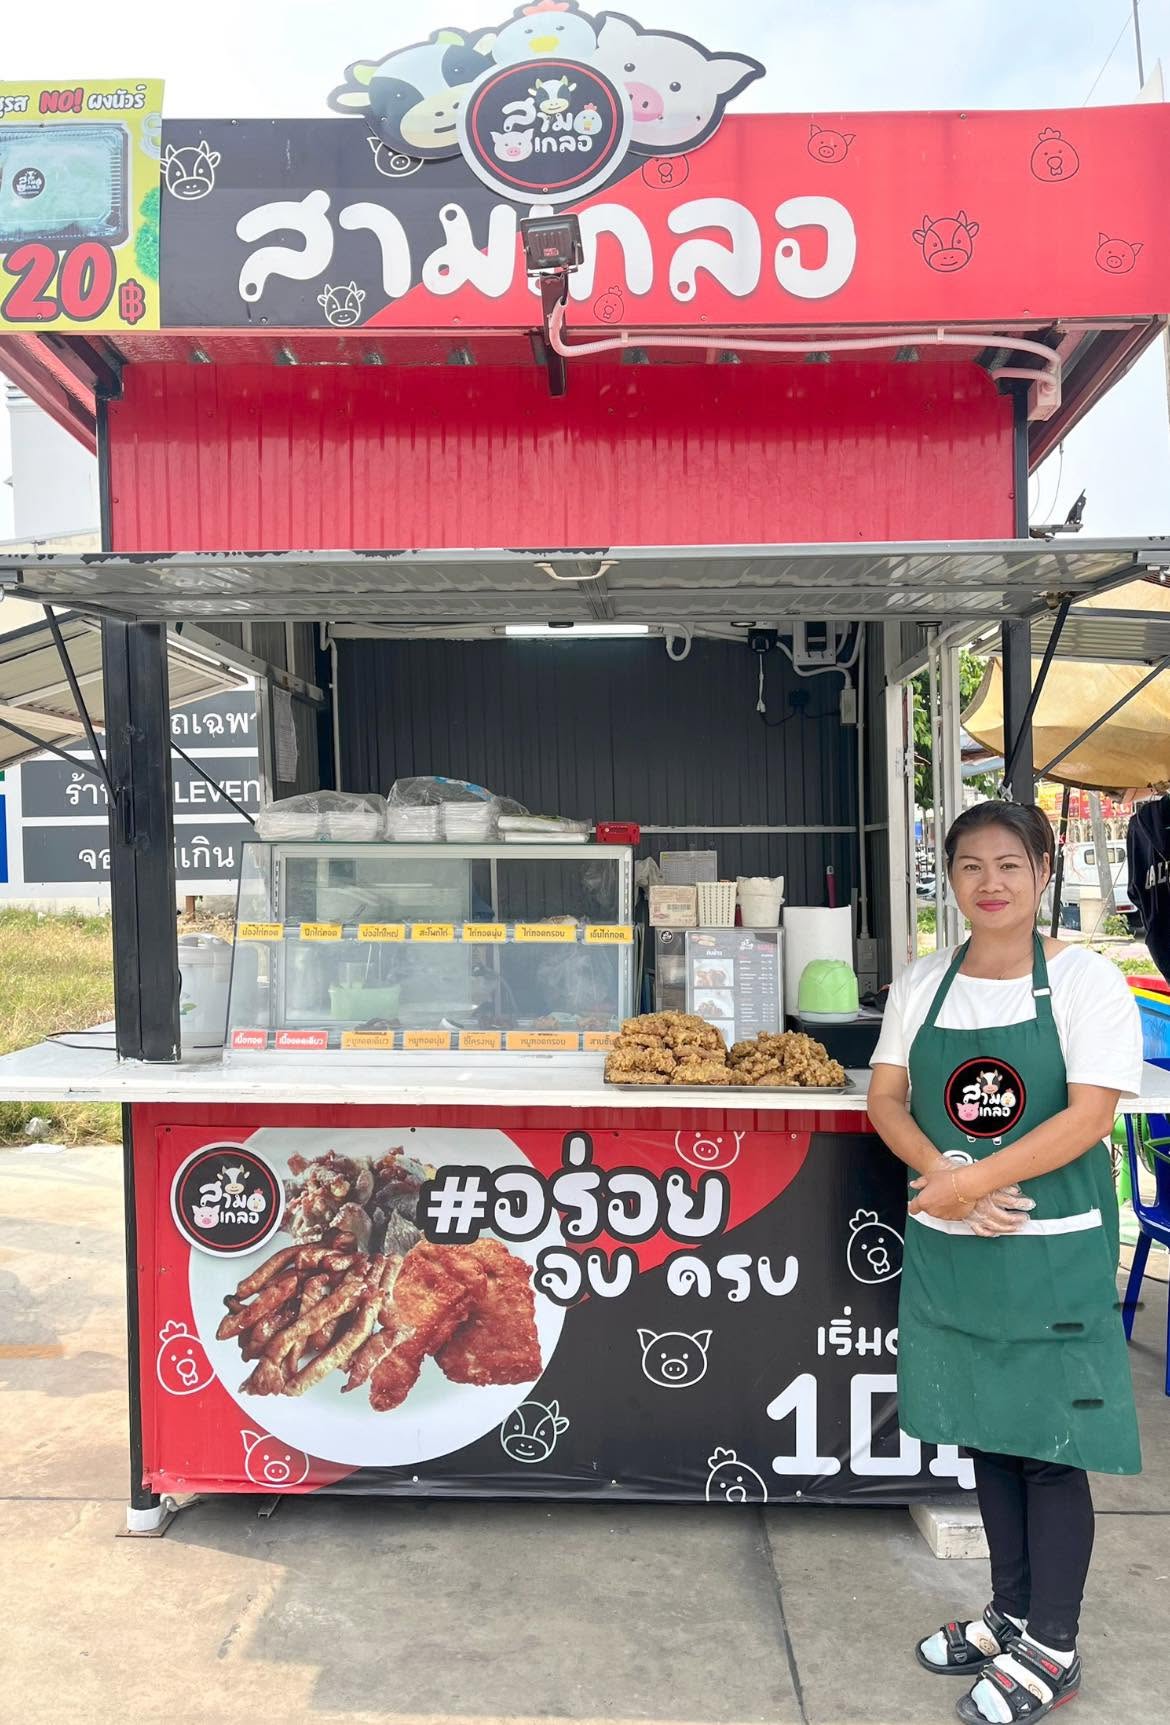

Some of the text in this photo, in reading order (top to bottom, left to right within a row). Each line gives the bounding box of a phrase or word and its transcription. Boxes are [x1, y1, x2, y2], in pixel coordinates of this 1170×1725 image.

[39, 87, 84, 114] NO!
[87, 84, 147, 110] ผงนัวร์
[502, 97, 573, 133] สาม
[534, 135, 593, 153] เกลอ
[236, 190, 857, 302] สามกลอ
[963, 1083, 1001, 1105] สาม
[980, 1106, 1011, 1118] เกลอ
[199, 1181, 247, 1208] สาม
[427, 1136, 723, 1236] #อร่อย
[220, 1211, 259, 1224] เกลอ
[541, 1252, 799, 1302] จบ ครบ
